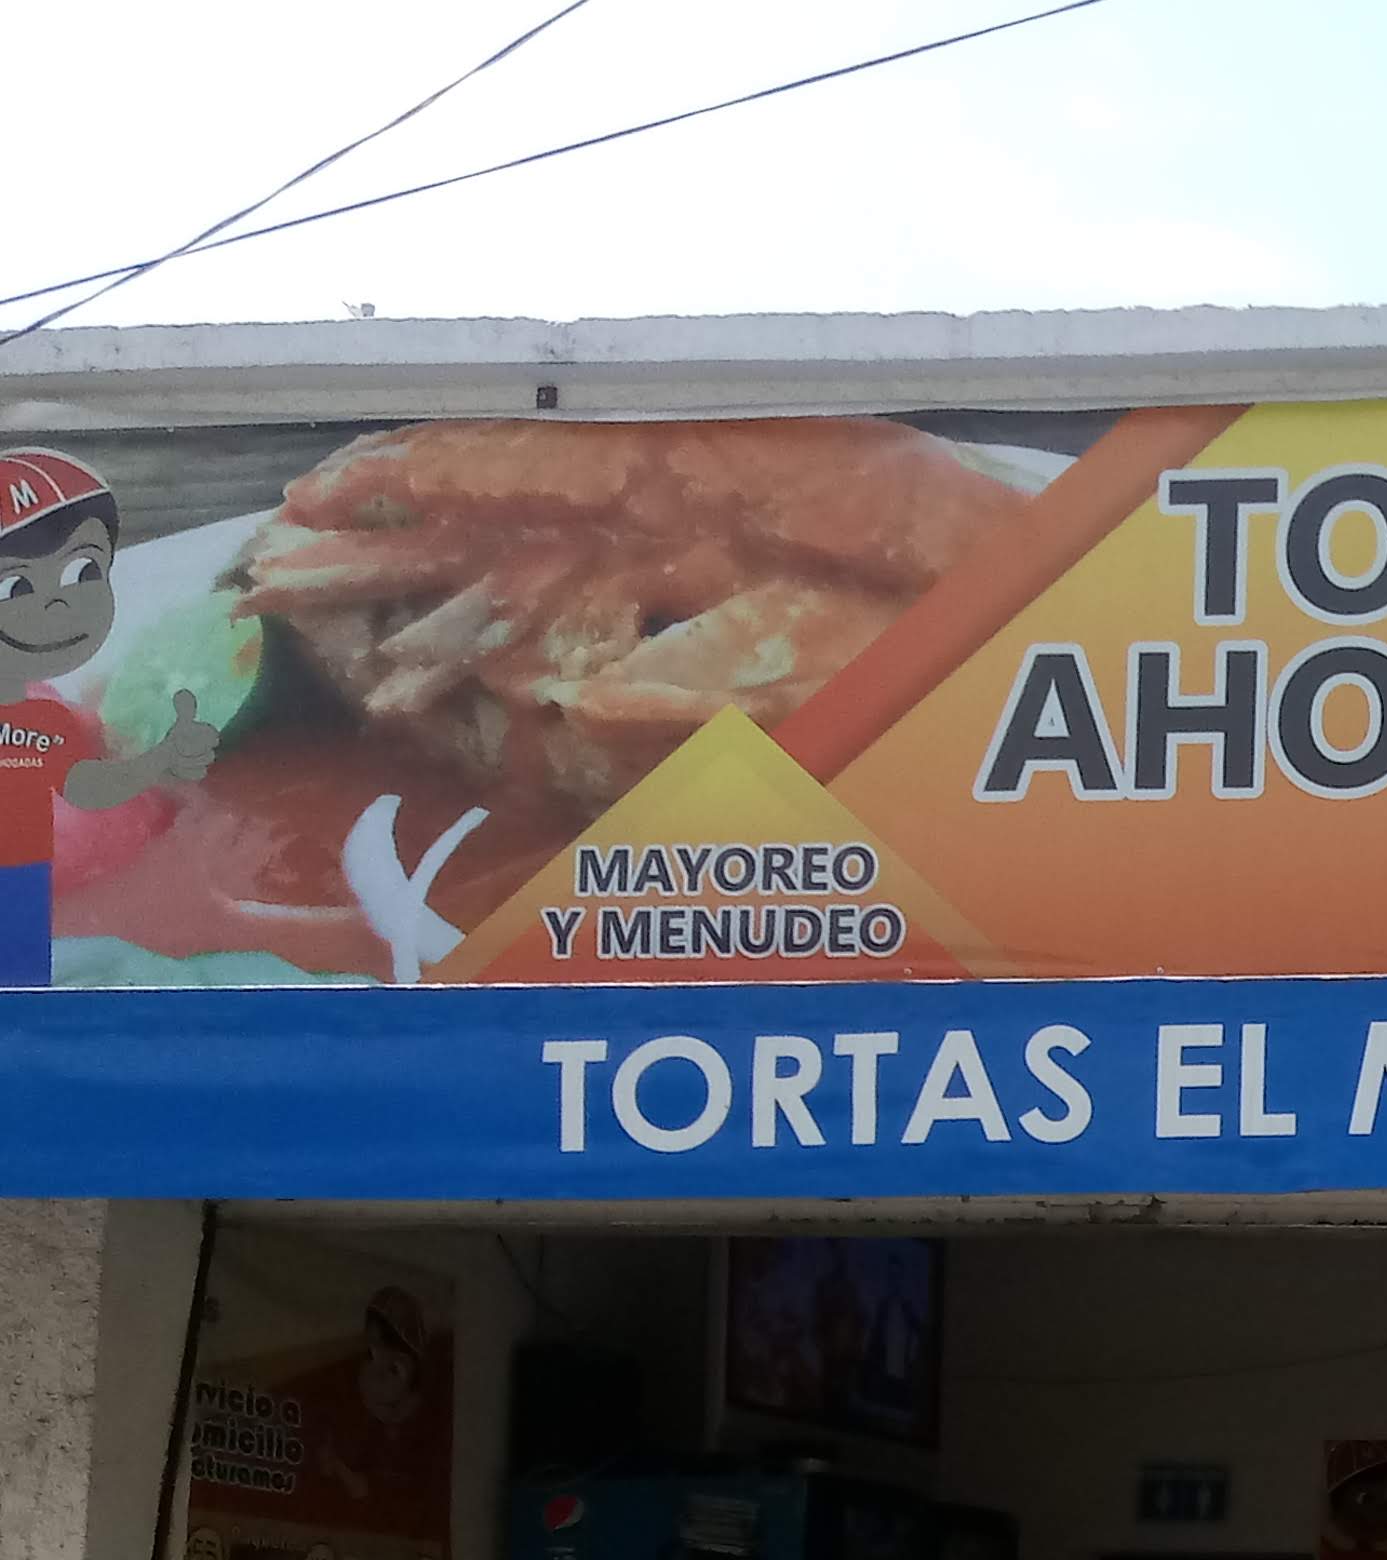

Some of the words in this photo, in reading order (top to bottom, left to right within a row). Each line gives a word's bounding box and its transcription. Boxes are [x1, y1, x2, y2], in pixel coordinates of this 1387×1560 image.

[576, 843, 878, 897] MAYOREO
[544, 908, 585, 958] Y
[597, 902, 906, 961] MENUDEO
[541, 1023, 1094, 1155] TORTAS
[1155, 1022, 1297, 1140] EL
